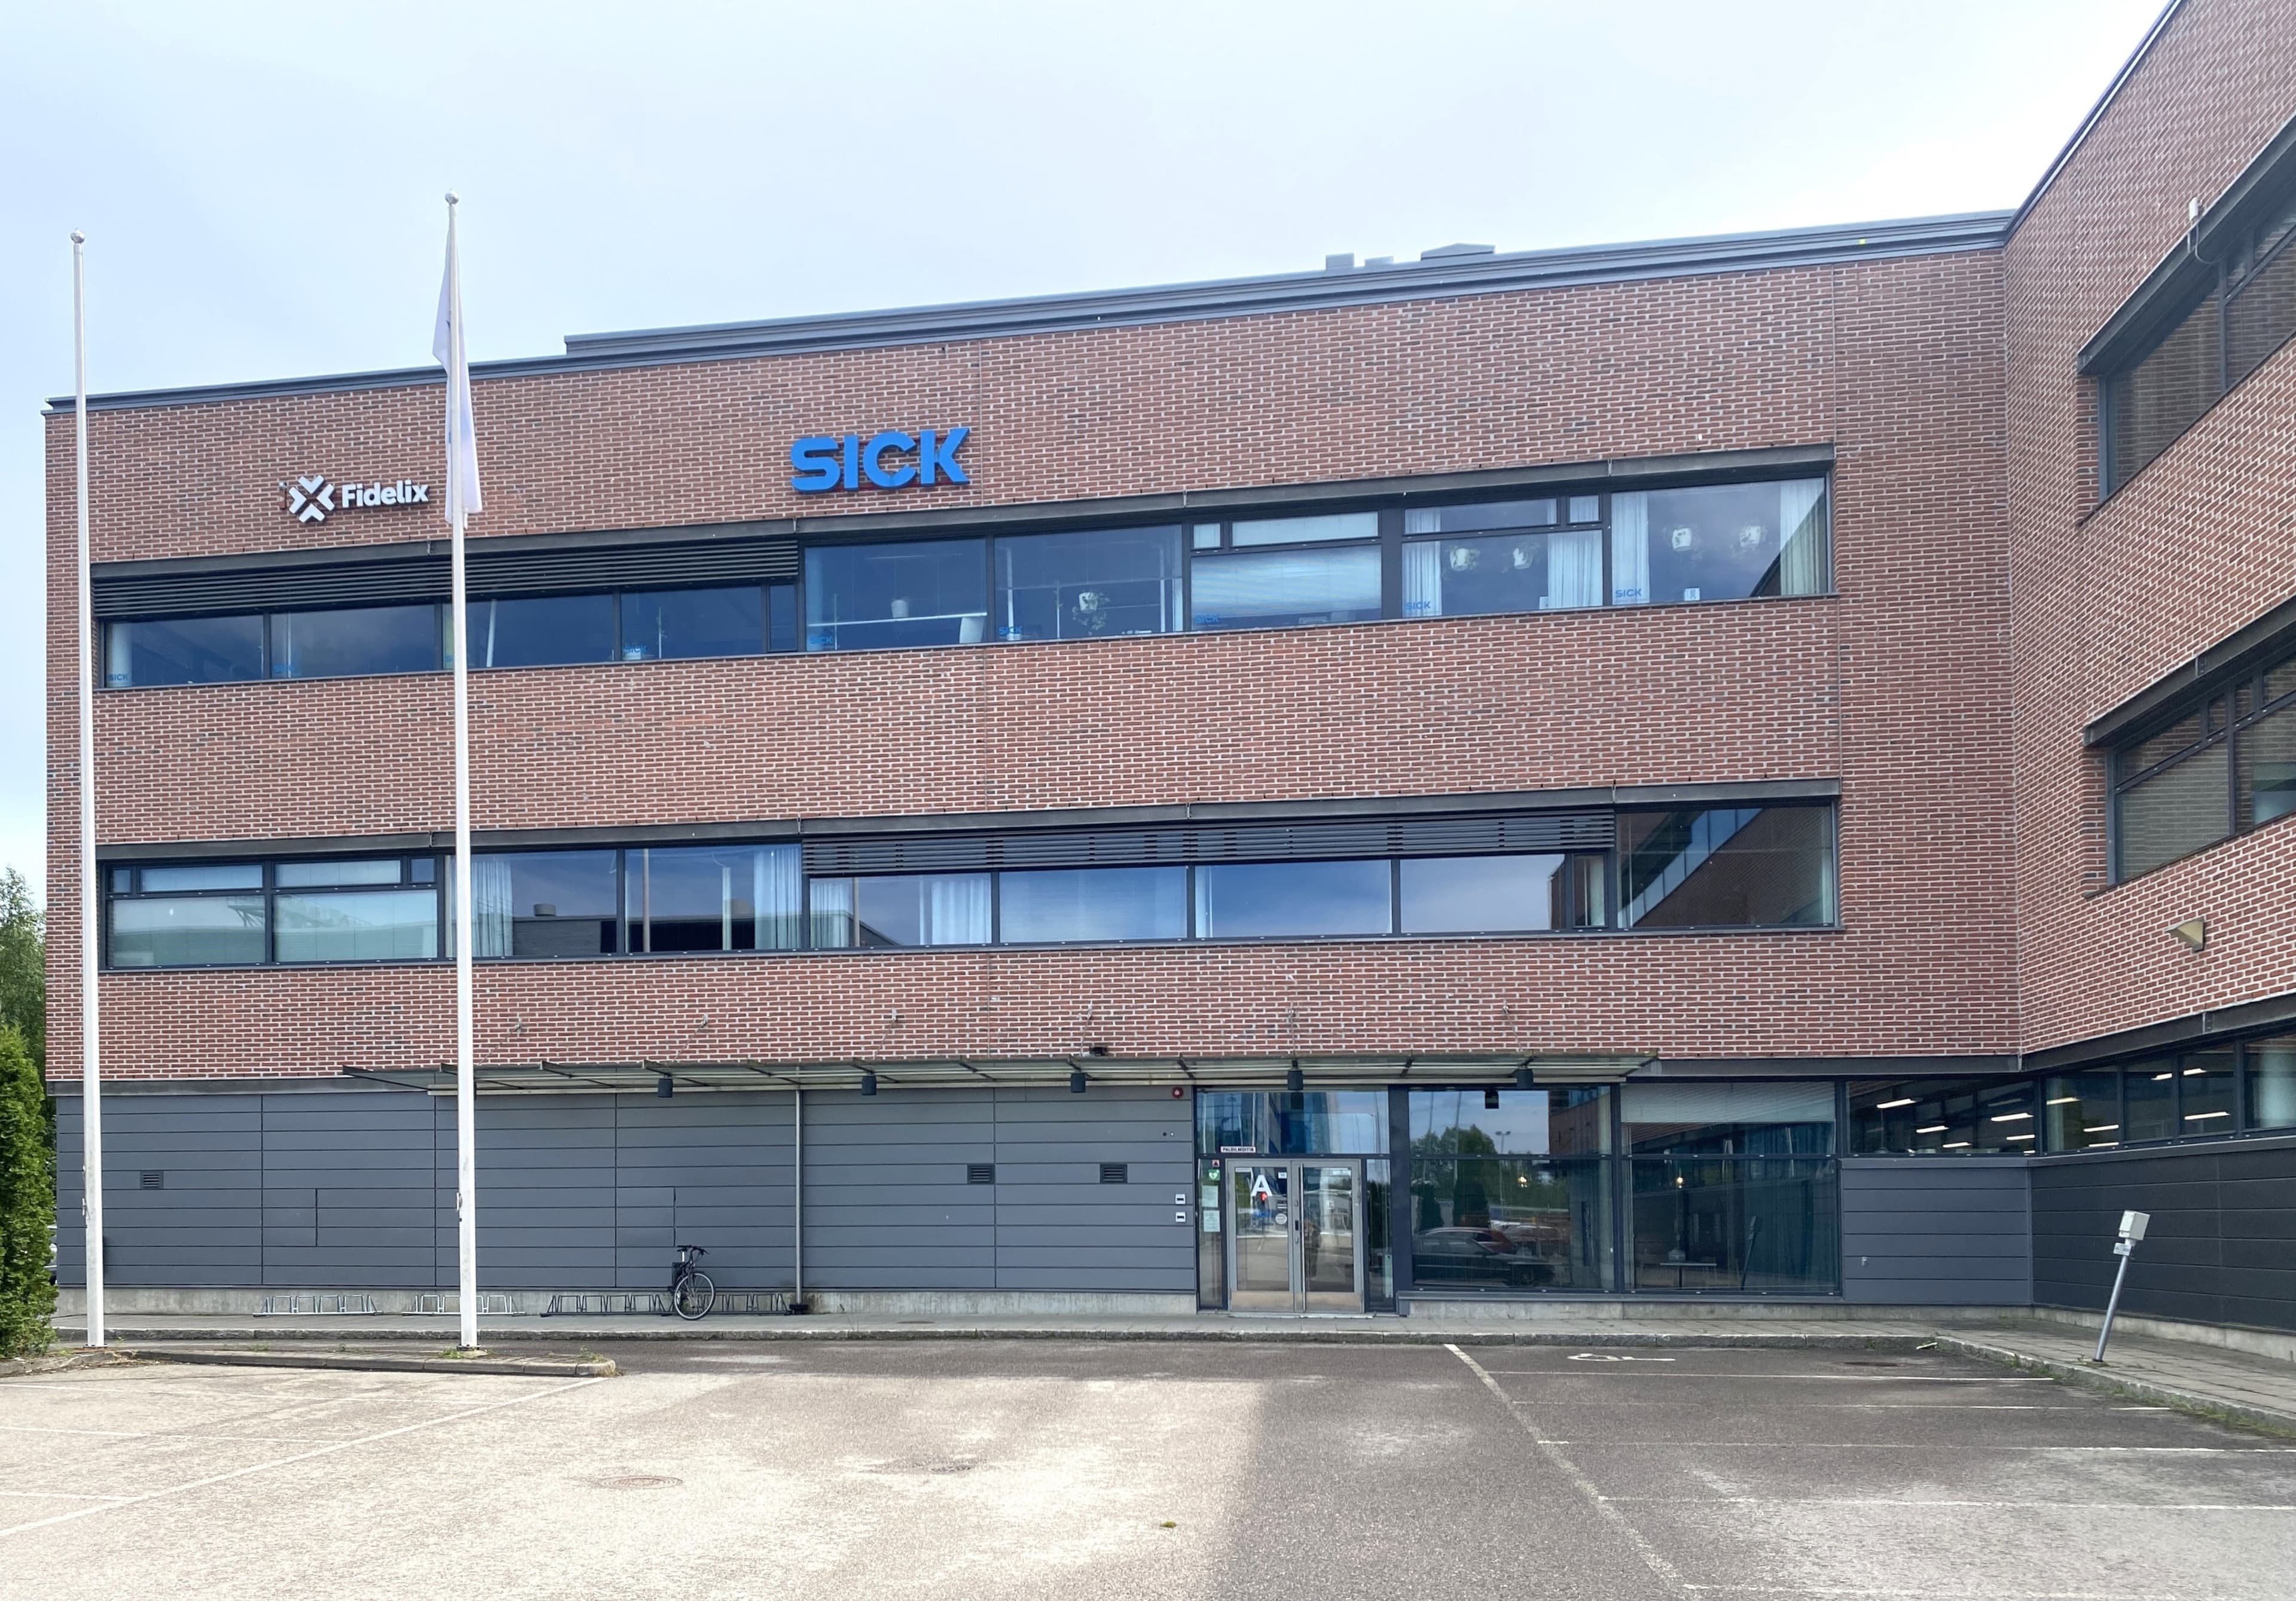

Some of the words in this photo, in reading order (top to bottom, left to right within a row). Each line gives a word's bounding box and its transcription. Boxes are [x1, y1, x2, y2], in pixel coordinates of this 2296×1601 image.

[790, 428, 970, 493] SICK
[341, 480, 429, 508] Fidelix
[1616, 588, 1642, 597] SICK
[1405, 601, 1431, 610] SICK
[999, 626, 1023, 635] SICK
[1250, 1175, 1273, 1197] A
